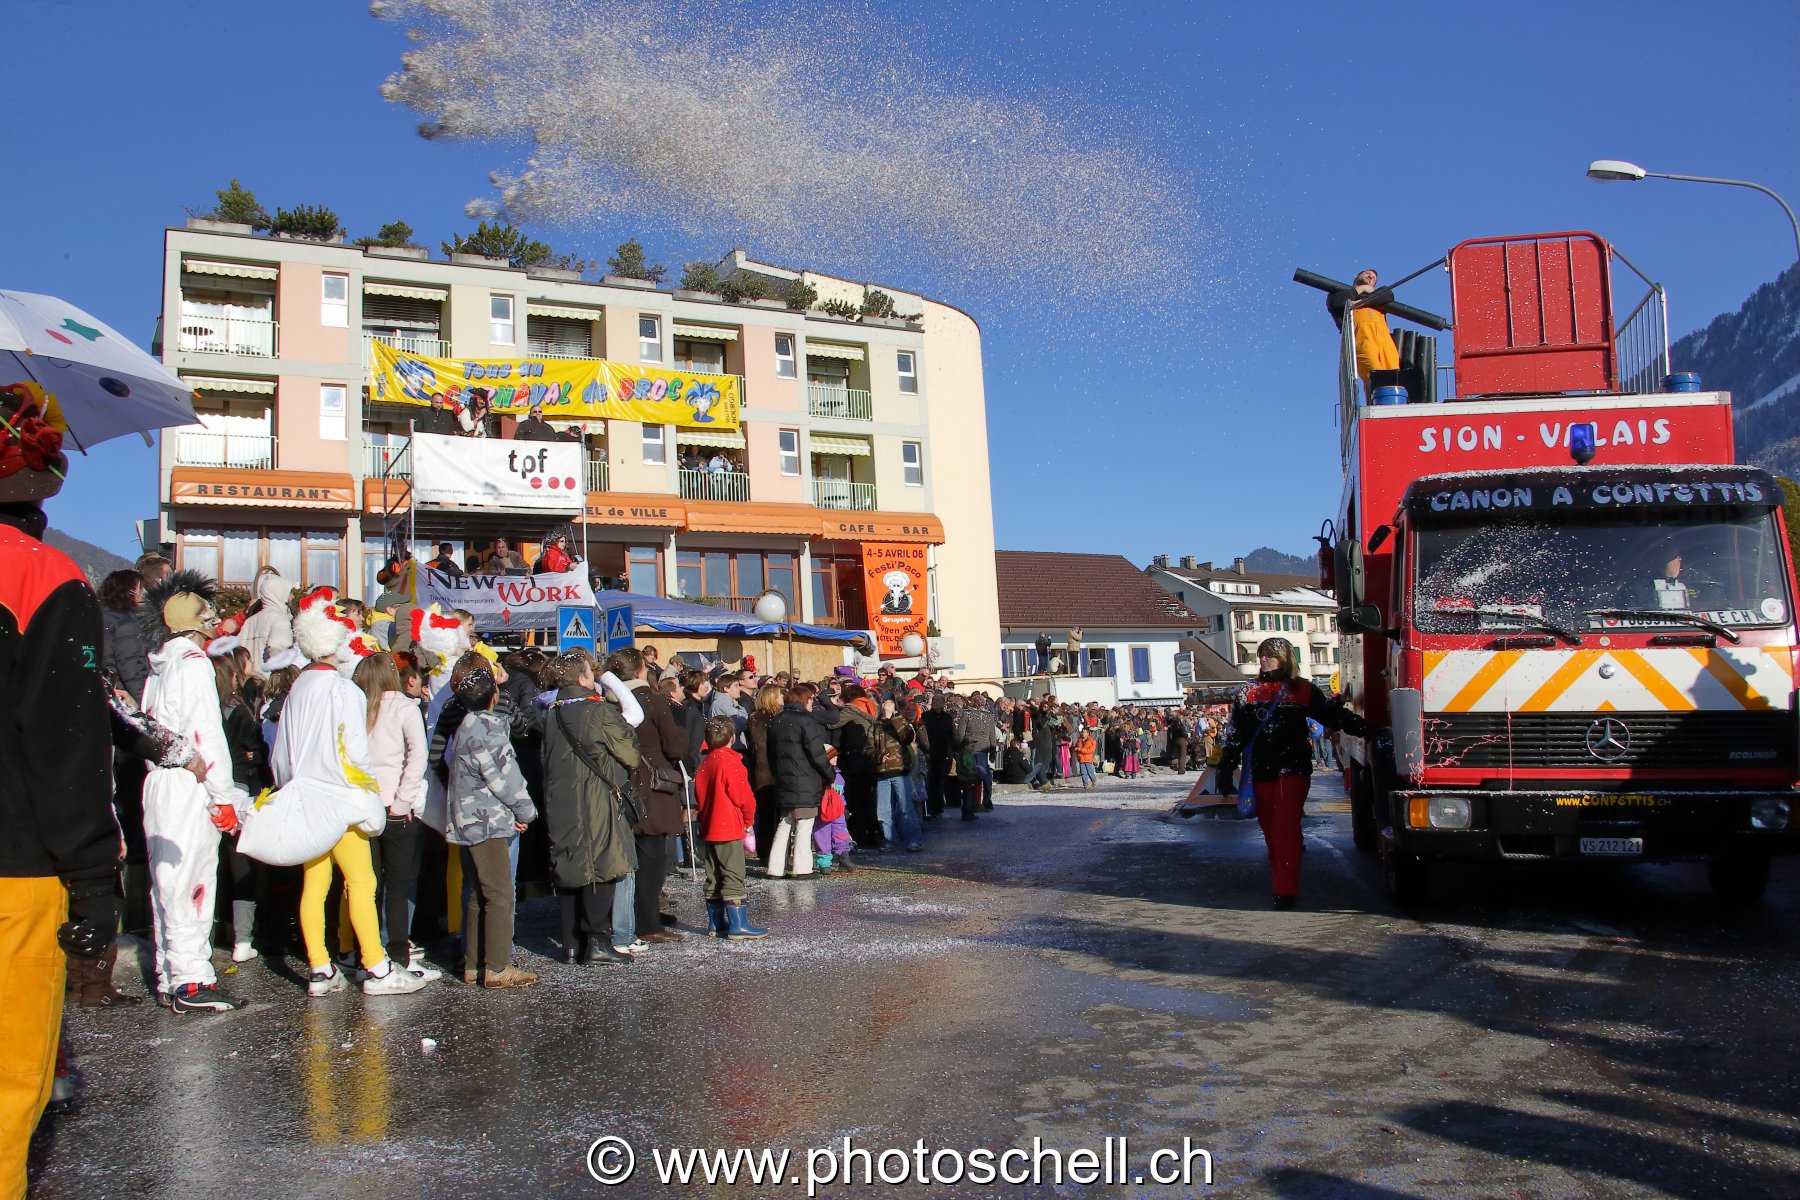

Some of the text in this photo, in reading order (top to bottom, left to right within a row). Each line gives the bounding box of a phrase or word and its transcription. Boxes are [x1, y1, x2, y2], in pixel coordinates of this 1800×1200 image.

[463, 361, 544, 379] Tous au
[582, 378, 608, 404] de
[617, 378, 683, 402] BROC
[1418, 424, 1502, 452] SION
[508, 448, 548, 479] tpf
[197, 484, 331, 500] RESTAURANT
[1430, 482, 1764, 512] CANON A CONFETTIS
[608, 507, 624, 517] de
[631, 508, 668, 518] VILLE
[839, 523, 875, 533] CAFE
[903, 526, 929, 535] BAR
[866, 548, 924, 559] 4-5 AVRIL 08
[426, 567, 581, 603] NEW WORK
[903, 616, 924, 631] Show
[83, 650, 96, 668] 2
